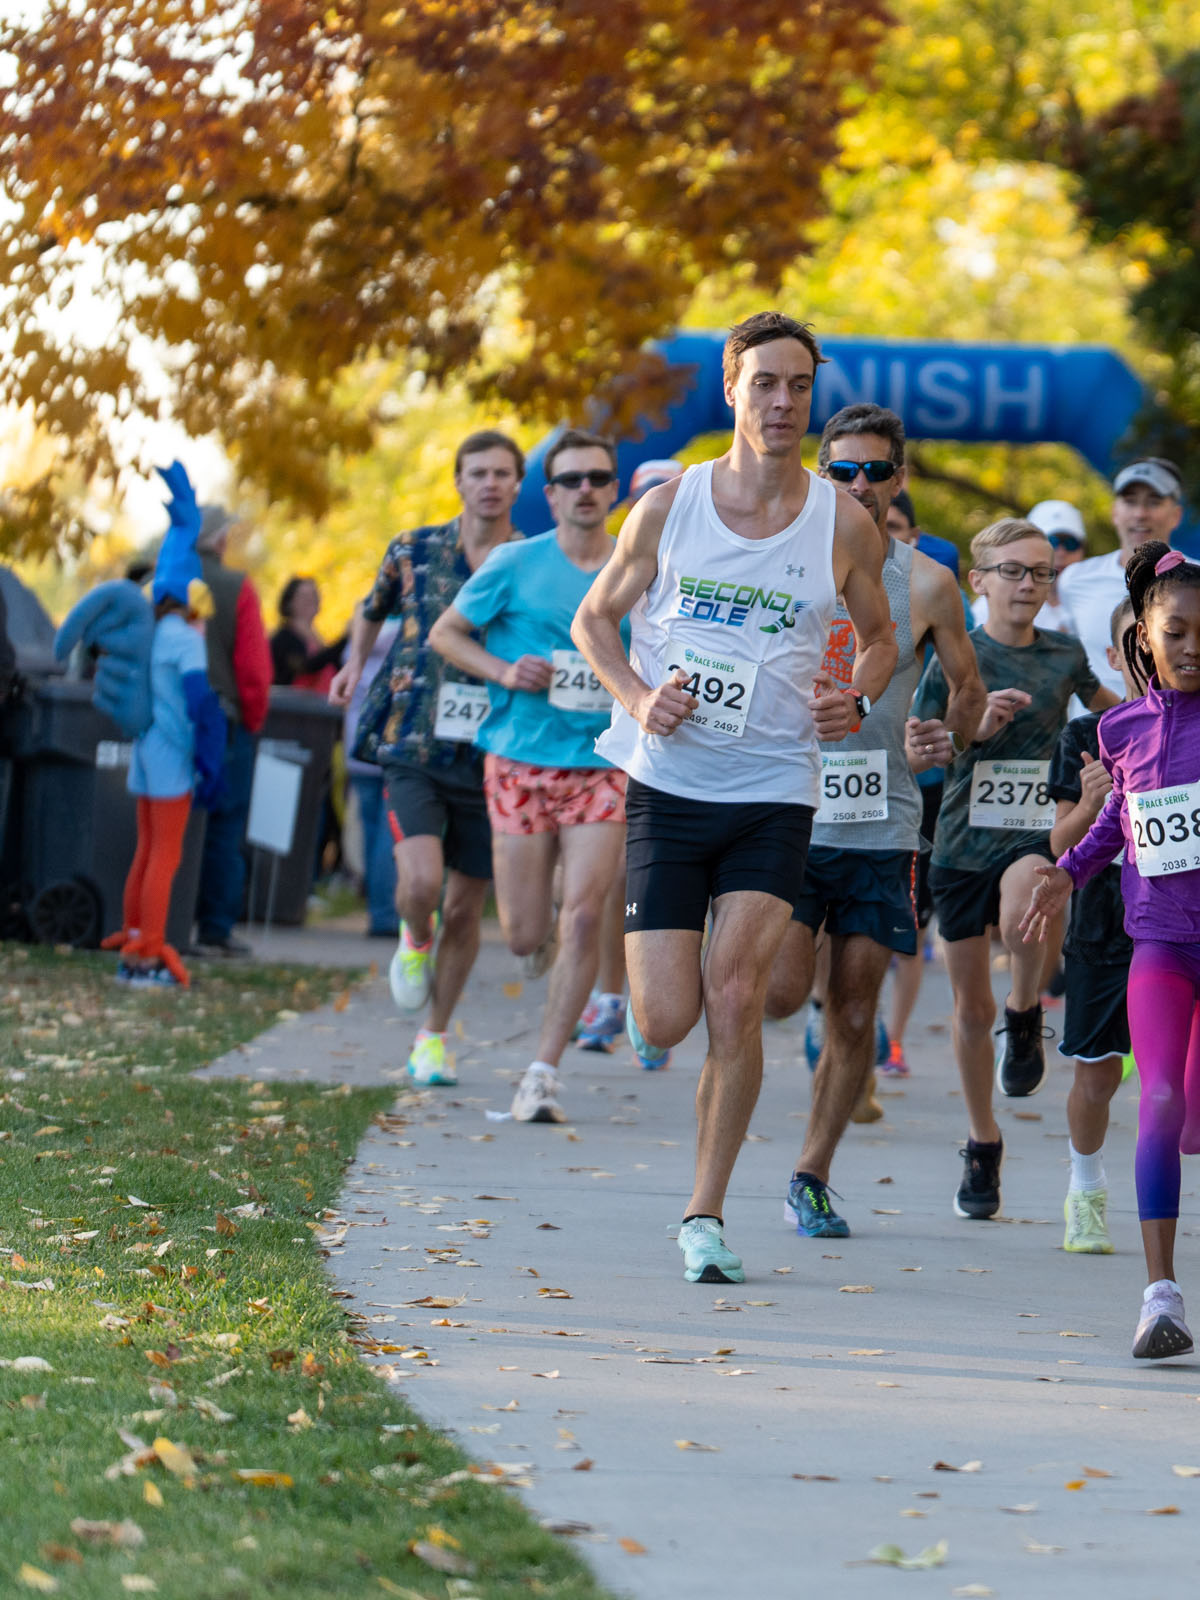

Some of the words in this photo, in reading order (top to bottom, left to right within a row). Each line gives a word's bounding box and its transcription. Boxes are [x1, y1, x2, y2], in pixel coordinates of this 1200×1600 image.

[816, 359, 1045, 431] NISH
[679, 576, 793, 613] SECOND
[678, 596, 750, 627] SOLE
[693, 655, 711, 668] RACE
[712, 660, 735, 673] SERIES
[555, 669, 603, 691] 249
[443, 699, 489, 722] 247
[713, 720, 739, 733] 2492
[829, 759, 846, 767] RACE
[847, 757, 868, 767] SERIES
[824, 771, 882, 799] 508
[977, 780, 1050, 806] 2378
[1145, 799, 1163, 809] RACE
[1164, 793, 1190, 806] SERIES
[833, 812, 857, 821] 2508
[862, 809, 884, 819] 2508
[1003, 817, 1025, 827] 2378
[1031, 819, 1053, 827] 2378
[1162, 858, 1188, 872] 2038
